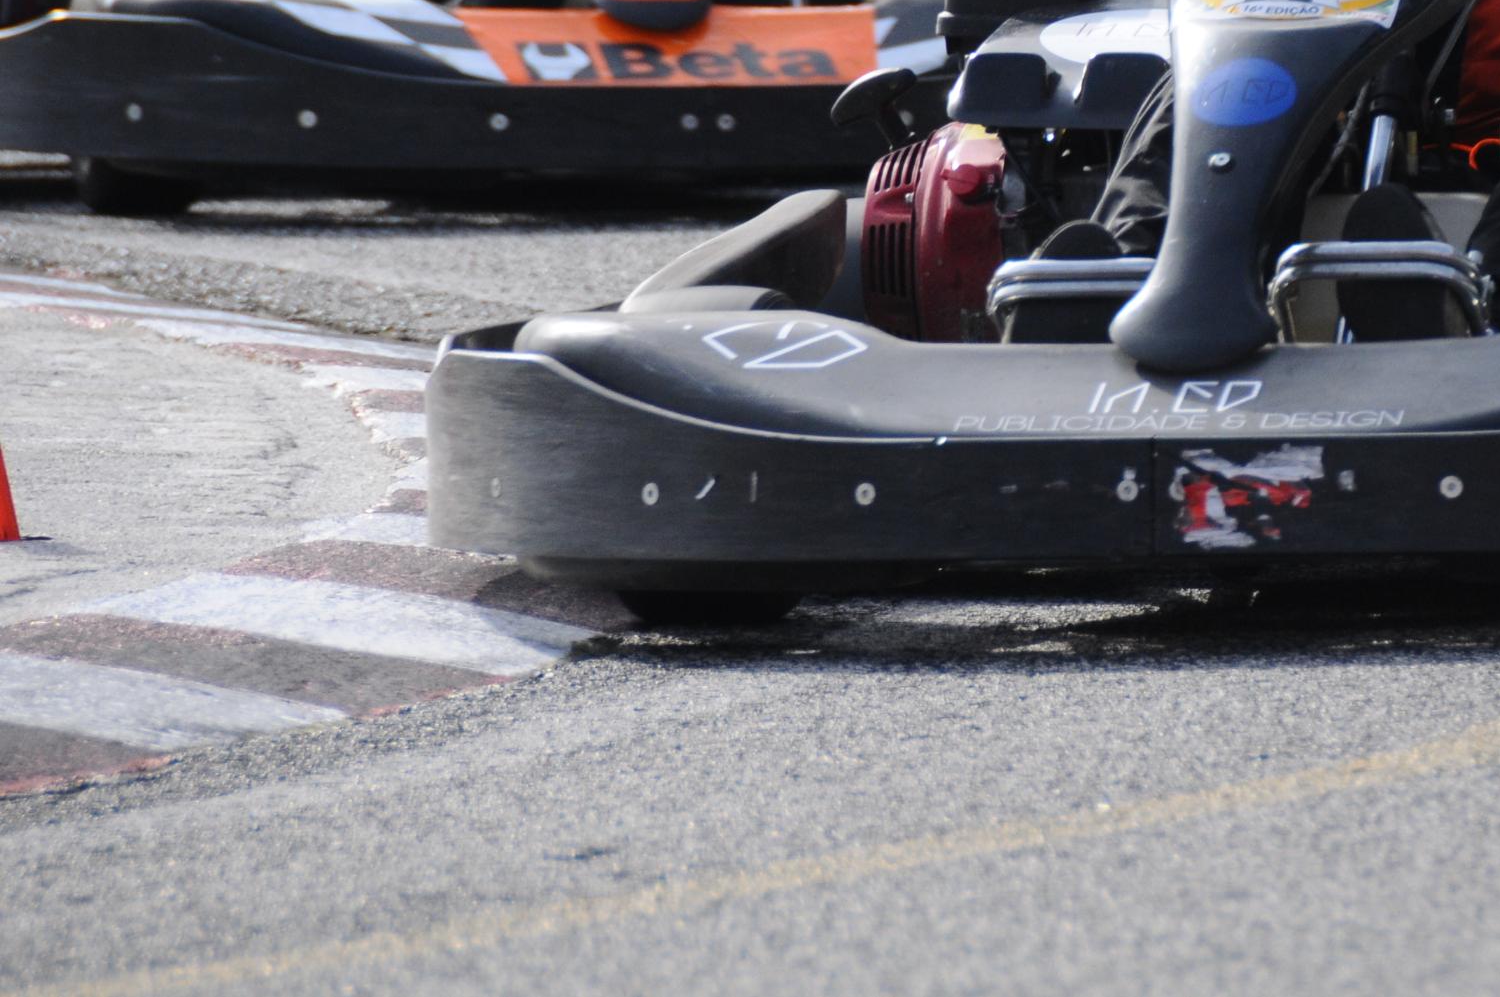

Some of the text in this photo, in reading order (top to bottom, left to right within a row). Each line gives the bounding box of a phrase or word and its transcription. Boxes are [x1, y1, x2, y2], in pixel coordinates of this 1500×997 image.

[603, 42, 838, 80] Beta
[952, 409, 1405, 433] PUBLICIDADE & DESIGN
